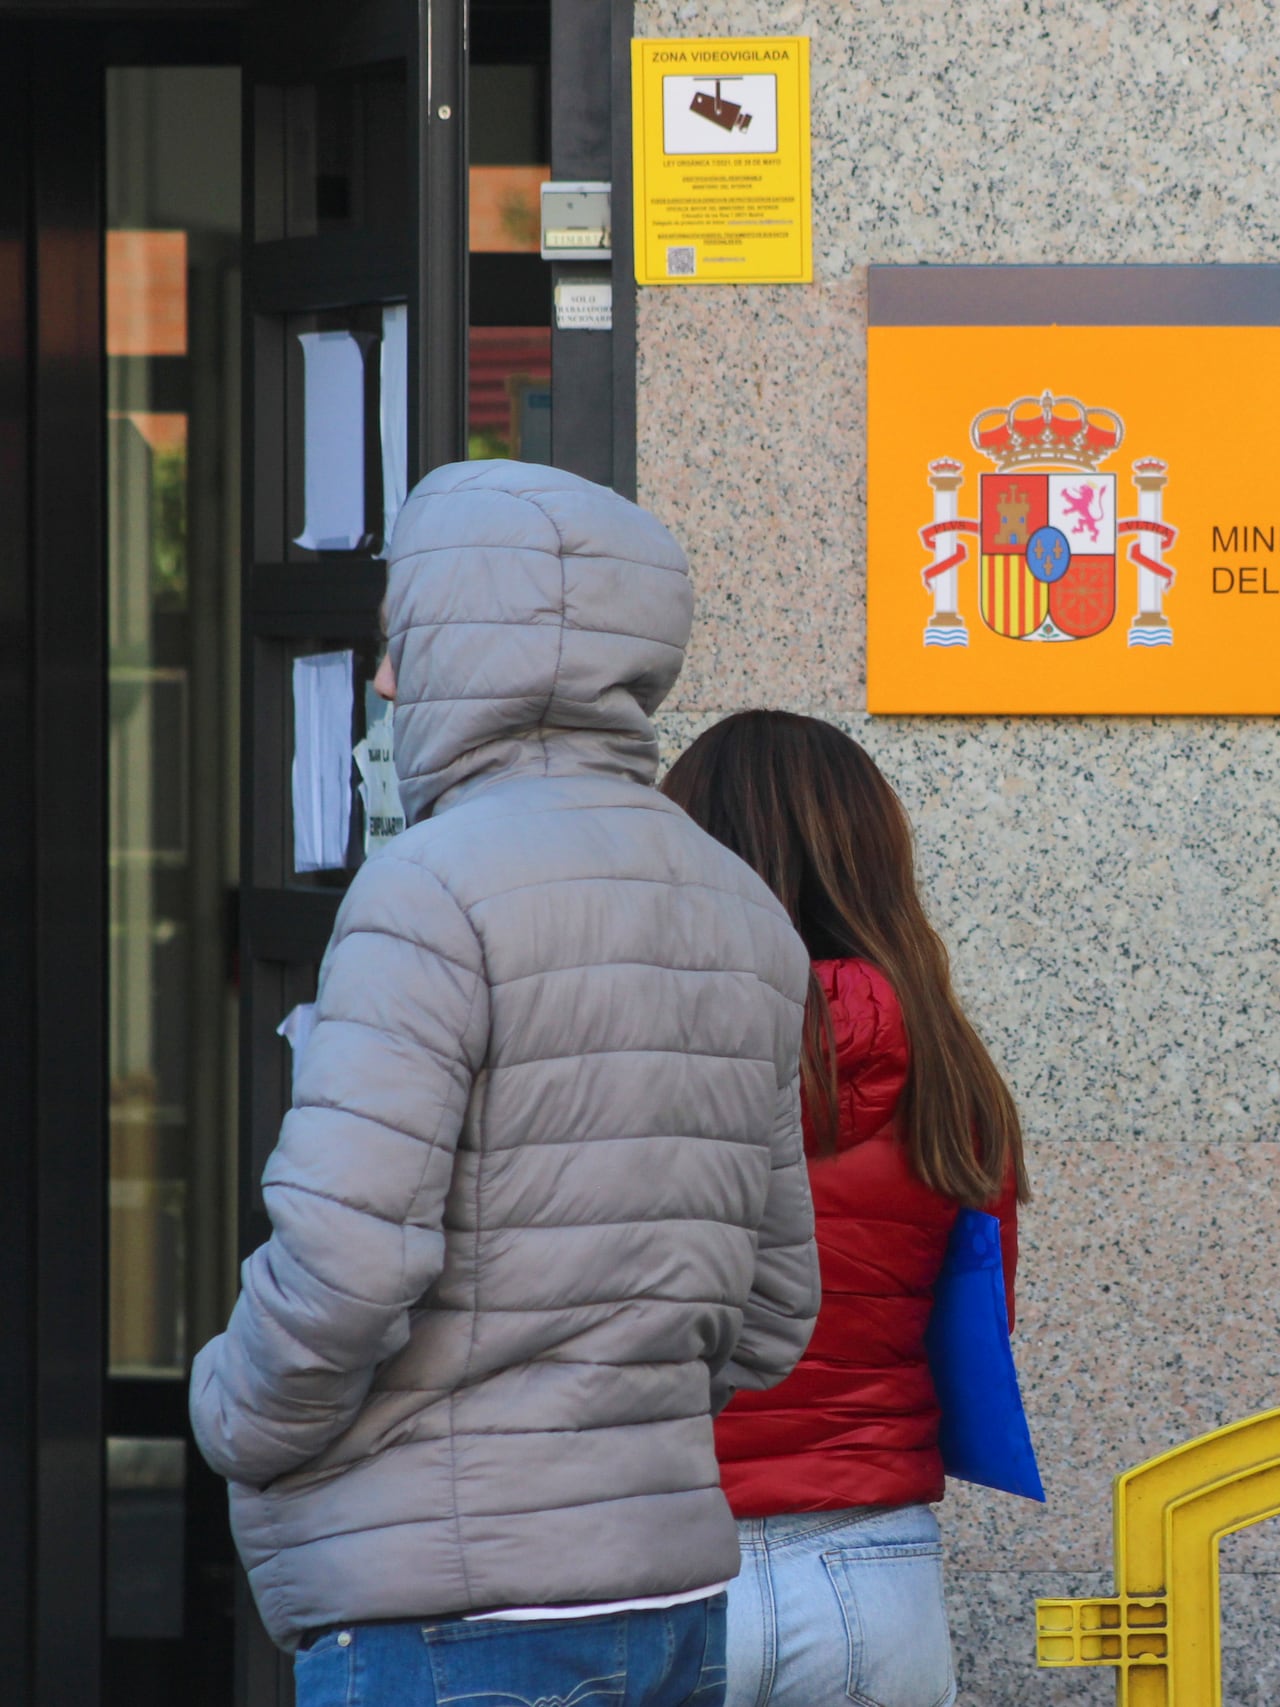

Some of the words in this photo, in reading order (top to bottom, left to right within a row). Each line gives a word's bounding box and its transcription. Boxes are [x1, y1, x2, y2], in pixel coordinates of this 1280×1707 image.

[652, 51, 687, 63] ZONA
[691, 50, 790, 62] VIDEOVIGILADA
[1212, 567, 1280, 595] DEL
